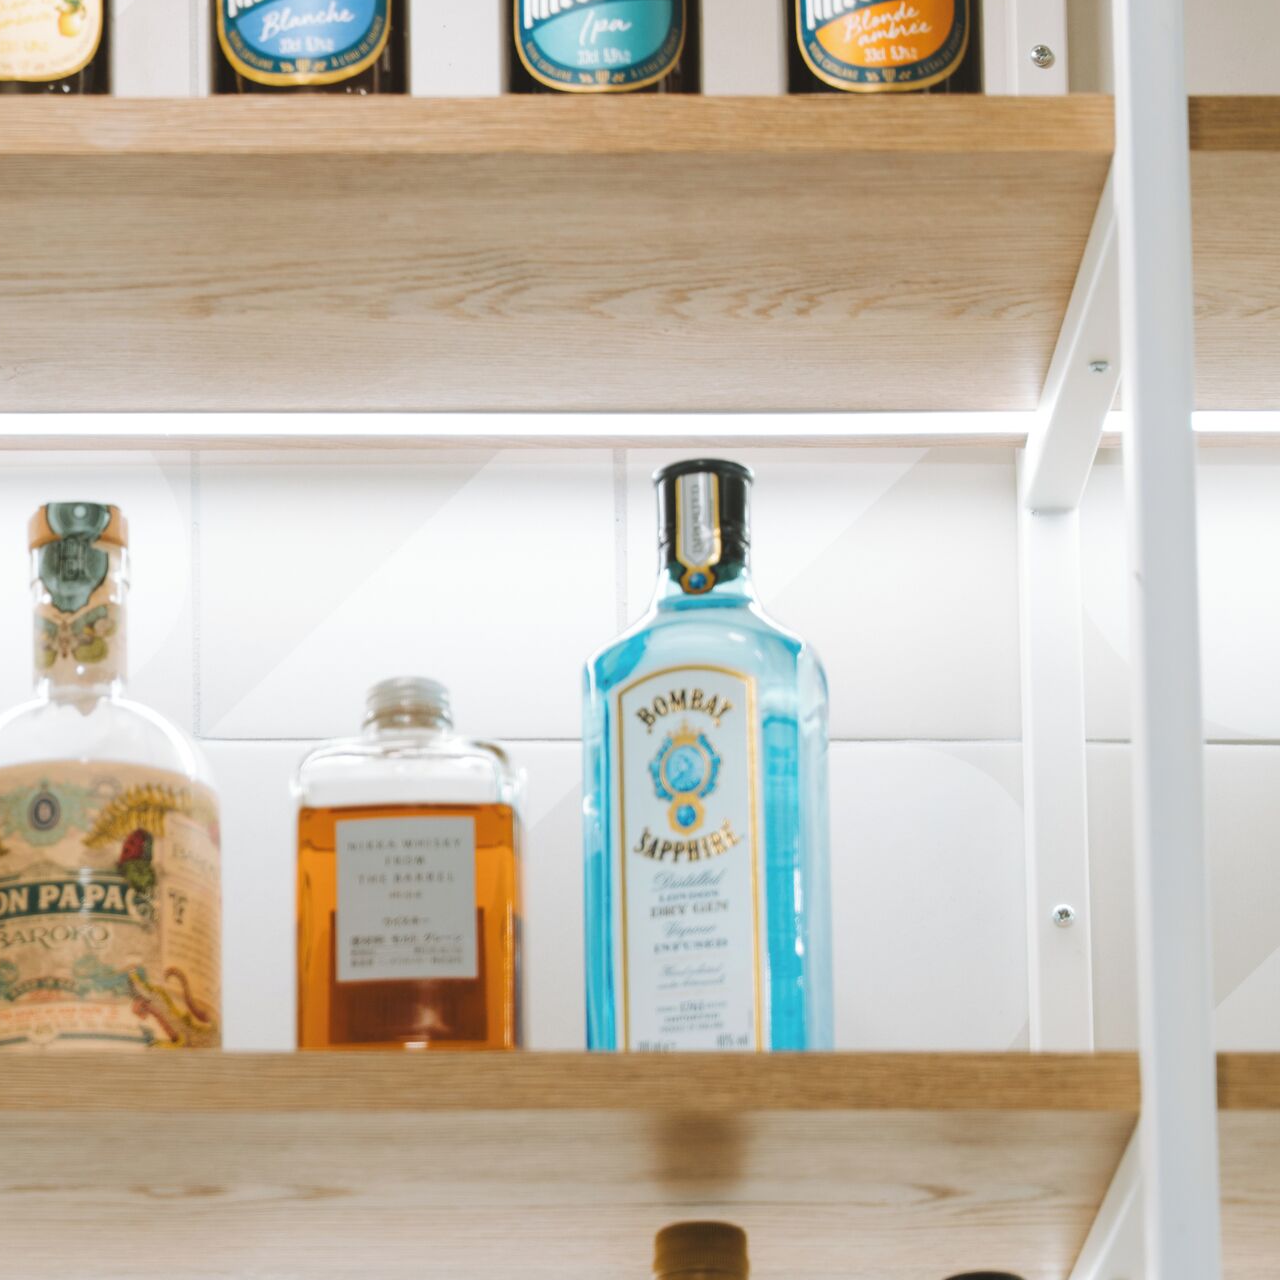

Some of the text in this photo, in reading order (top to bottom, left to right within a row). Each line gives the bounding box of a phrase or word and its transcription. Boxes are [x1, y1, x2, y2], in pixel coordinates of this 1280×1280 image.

[258, 0, 355, 44] Blanche
[843, 1, 920, 45] Blonde
[635, 686, 735, 730] BOMBAY
[632, 815, 744, 864] SAPPHIRE
[38, 882, 125, 913] PAPA
